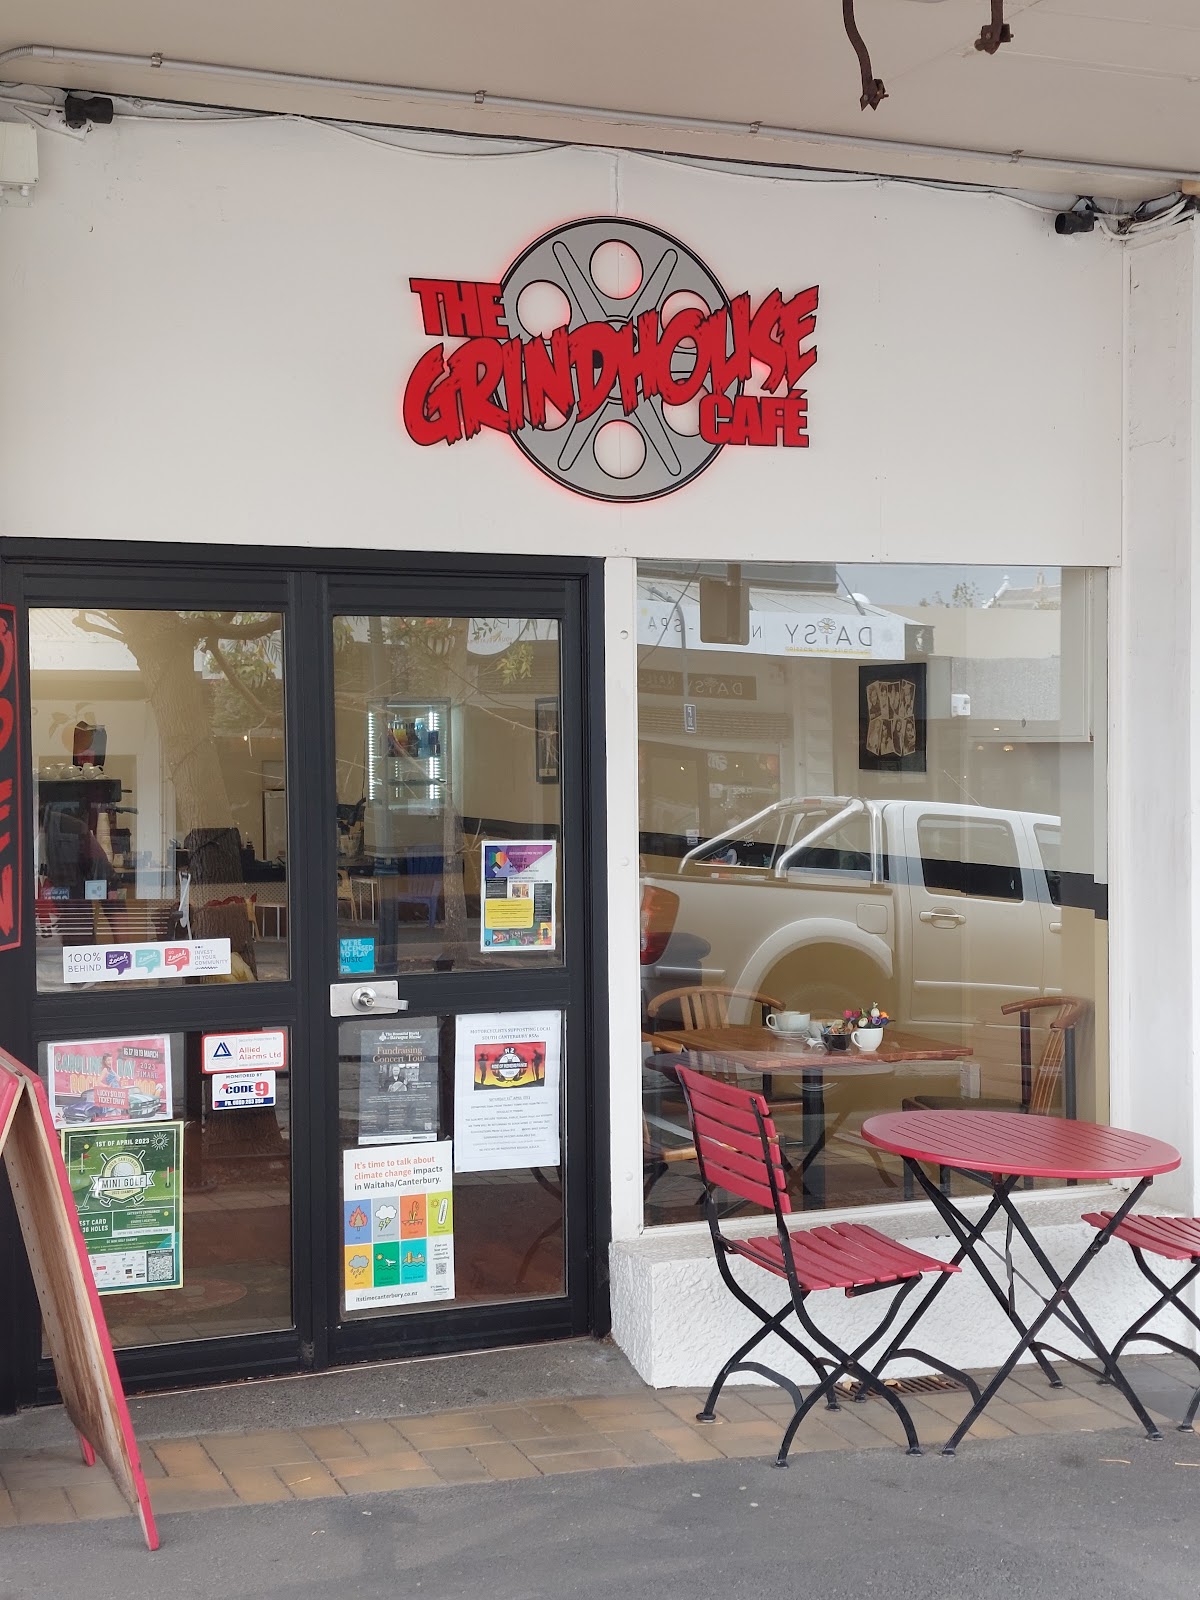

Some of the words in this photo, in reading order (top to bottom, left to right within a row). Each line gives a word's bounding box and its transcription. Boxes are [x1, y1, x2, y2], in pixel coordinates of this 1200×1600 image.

[408, 277, 510, 340] THE
[402, 284, 820, 448] GRINDHOUSE
[698, 389, 810, 449] CAFÉ
[67, 952, 102, 964] 100%
[67, 964, 102, 973] BEHIND
[239, 1046, 261, 1054] Allied
[377, 1046, 423, 1056] Fundraising
[239, 1053, 267, 1061] Alarms
[372, 1055, 404, 1063] Concert
[407, 1054, 426, 1062] Tour
[226, 1085, 254, 1094] CODE
[367, 1160, 385, 1168] time
[396, 1157, 411, 1166] talk
[413, 1156, 435, 1164] about
[354, 1172, 383, 1180] climate
[384, 1169, 412, 1178] change
[413, 1166, 443, 1175] impacts
[101, 1179, 121, 1189] MINI
[124, 1177, 144, 1187] GOLF
[363, 1177, 442, 1190] Waitaha/Canterbury.
[79, 1219, 91, 1227] EST
[91, 1218, 107, 1226] CARD
[90, 1225, 109, 1233] HOLES
[355, 1291, 418, 1302] itstimecanterbury.co.nz
